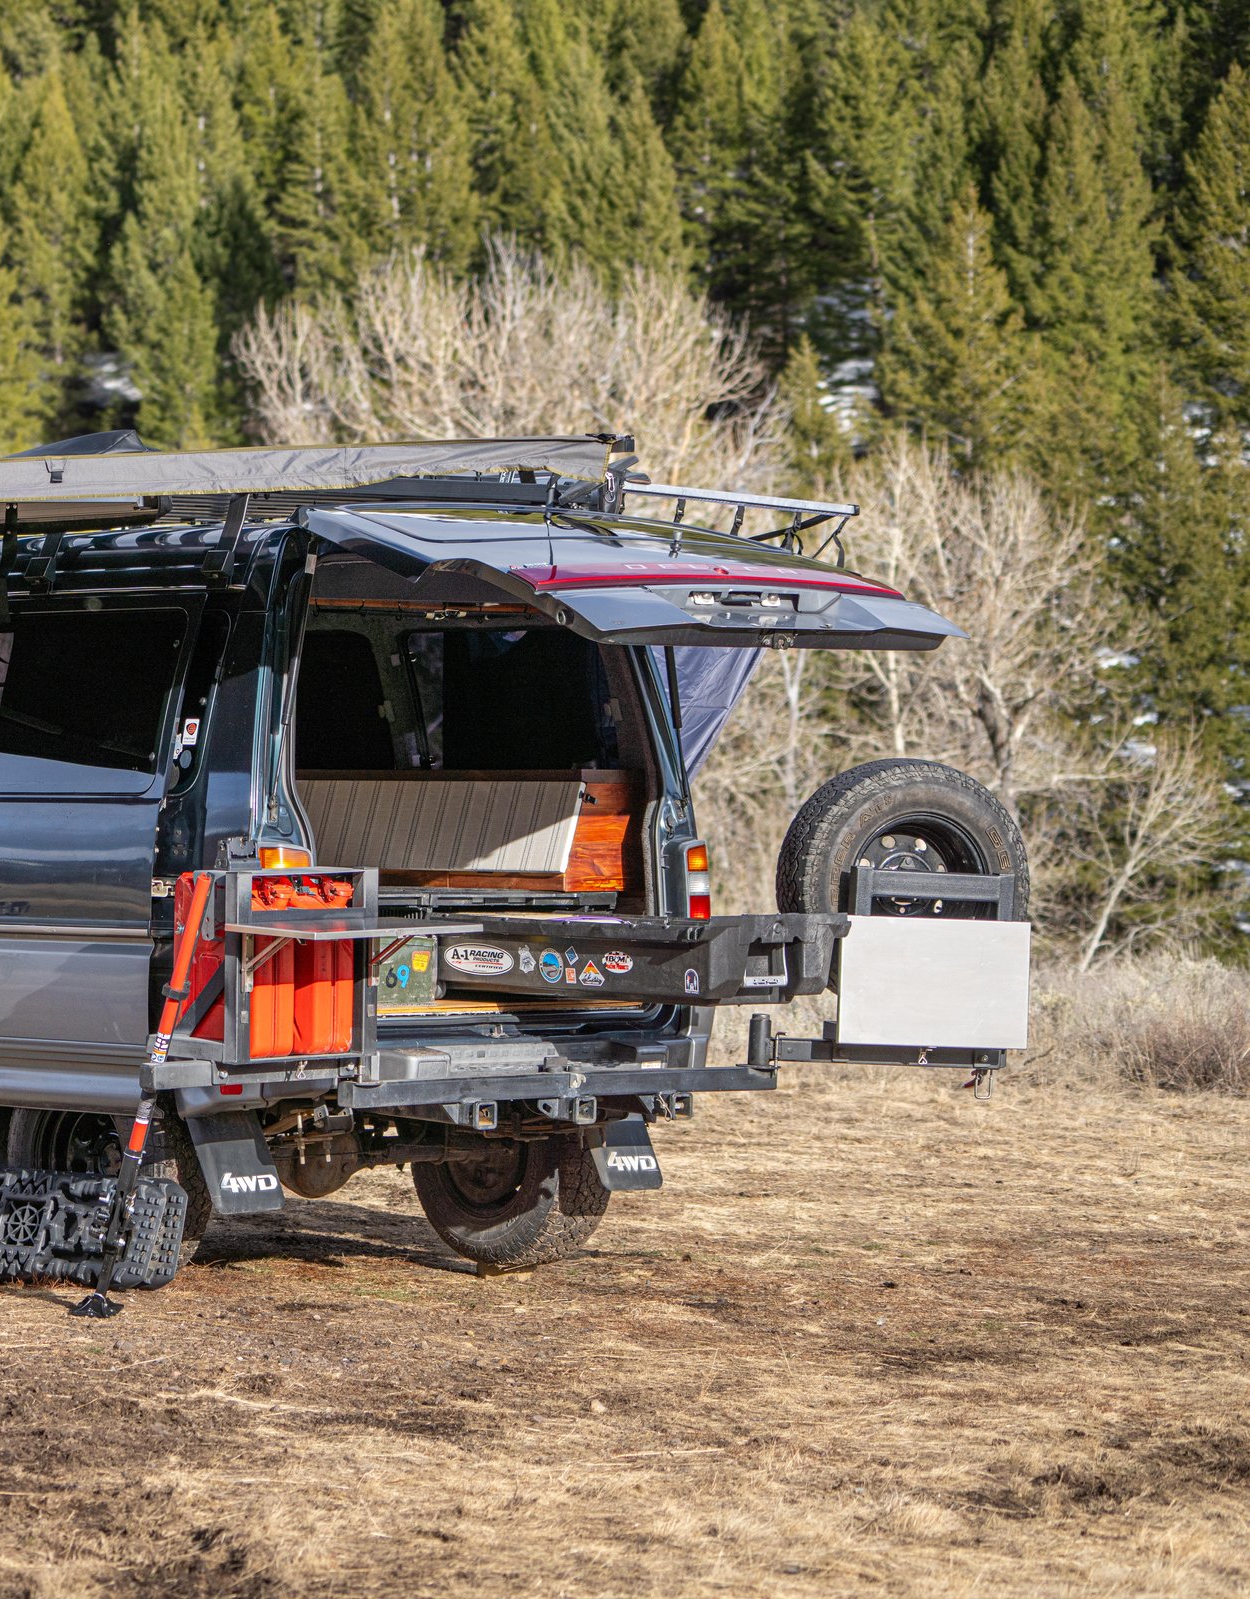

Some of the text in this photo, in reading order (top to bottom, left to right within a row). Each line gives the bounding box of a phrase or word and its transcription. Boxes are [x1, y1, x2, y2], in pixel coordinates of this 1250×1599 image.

[451, 948, 504, 961] A-1 RACING
[385, 964, 411, 989] 69
[607, 1151, 658, 1171] 4WD
[220, 1172, 278, 1193] 4WD
